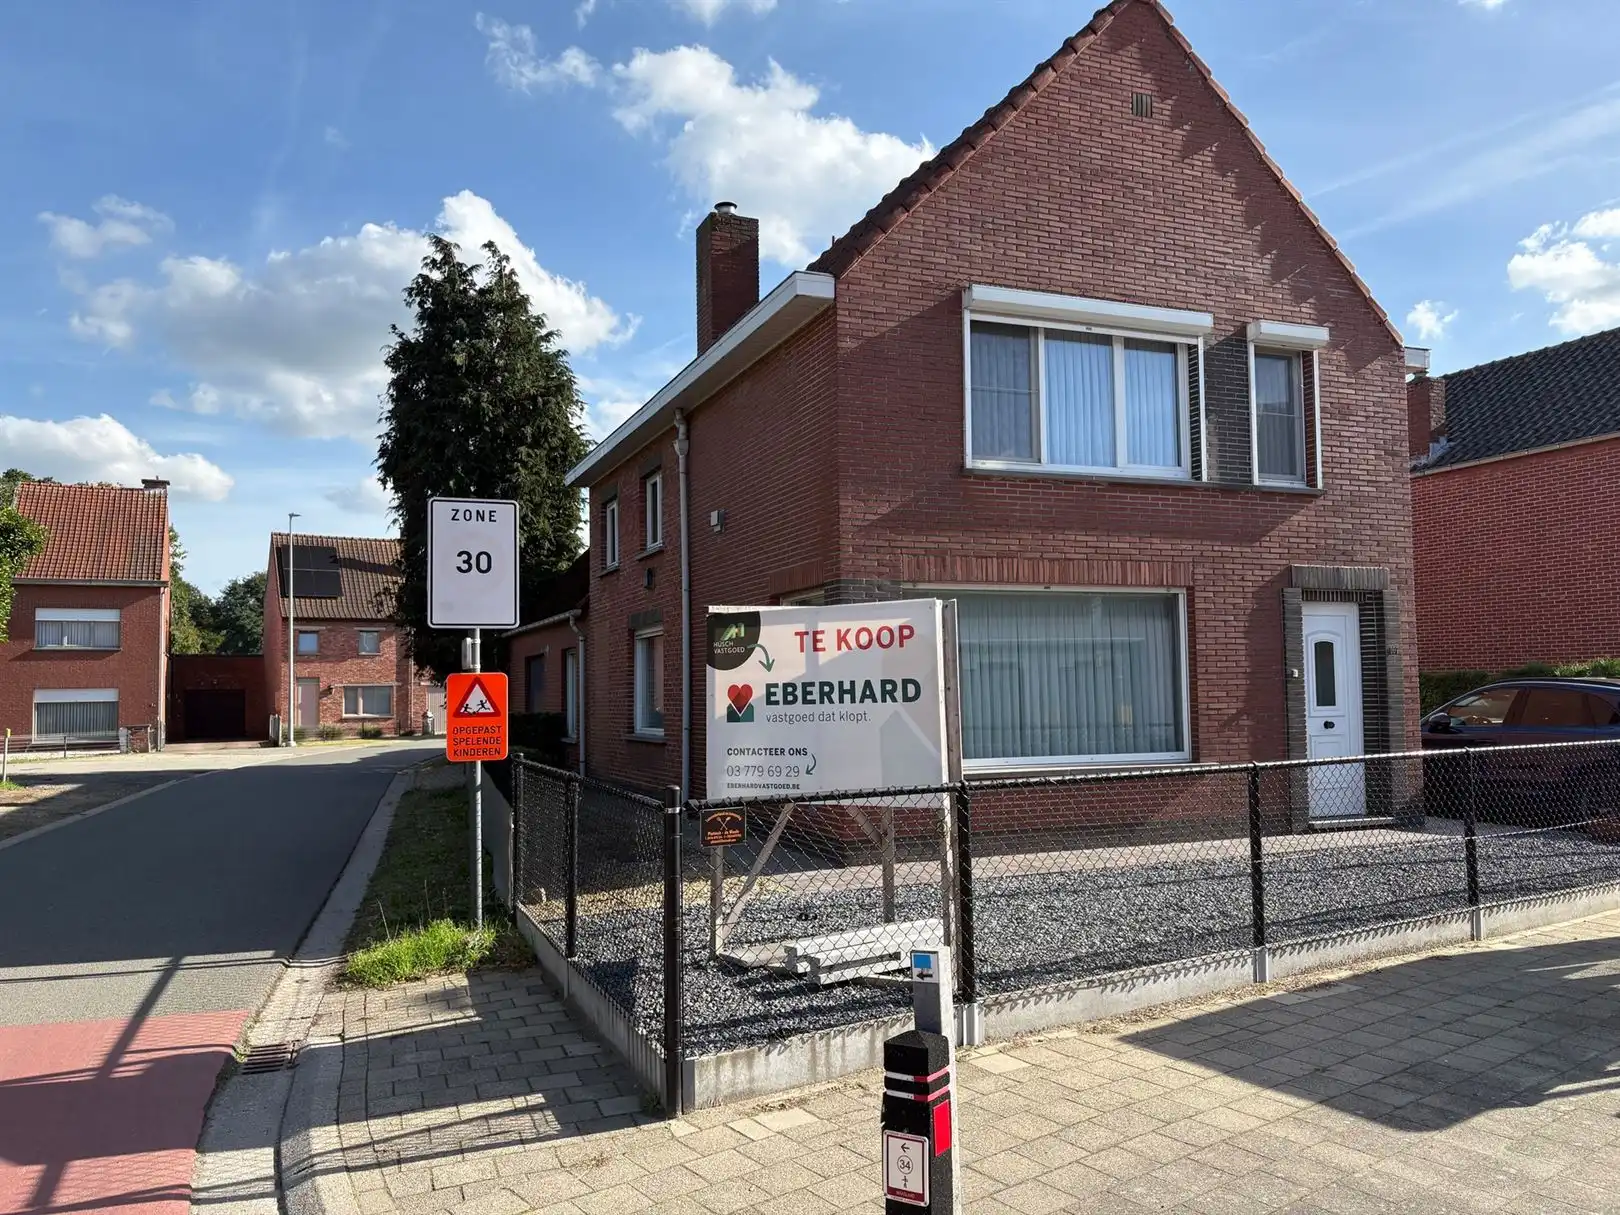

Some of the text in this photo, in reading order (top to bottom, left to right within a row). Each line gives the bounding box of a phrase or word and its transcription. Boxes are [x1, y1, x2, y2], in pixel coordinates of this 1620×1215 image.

[451, 509, 497, 523] ZONE
[456, 550, 492, 574] 30
[794, 624, 915, 653] TE KOOP
[765, 678, 922, 706] EBERHARD
[766, 710, 872, 724] vastgoed dat klopt.
[452, 725, 502, 735] OPGEPAST
[453, 736, 501, 746] SPELENDE
[453, 747, 501, 757] KINDEREN
[727, 747, 808, 756] CONTACTEER ONS
[726, 766, 800, 777] 03 779 69 29
[899, 1159, 911, 1170] 34
